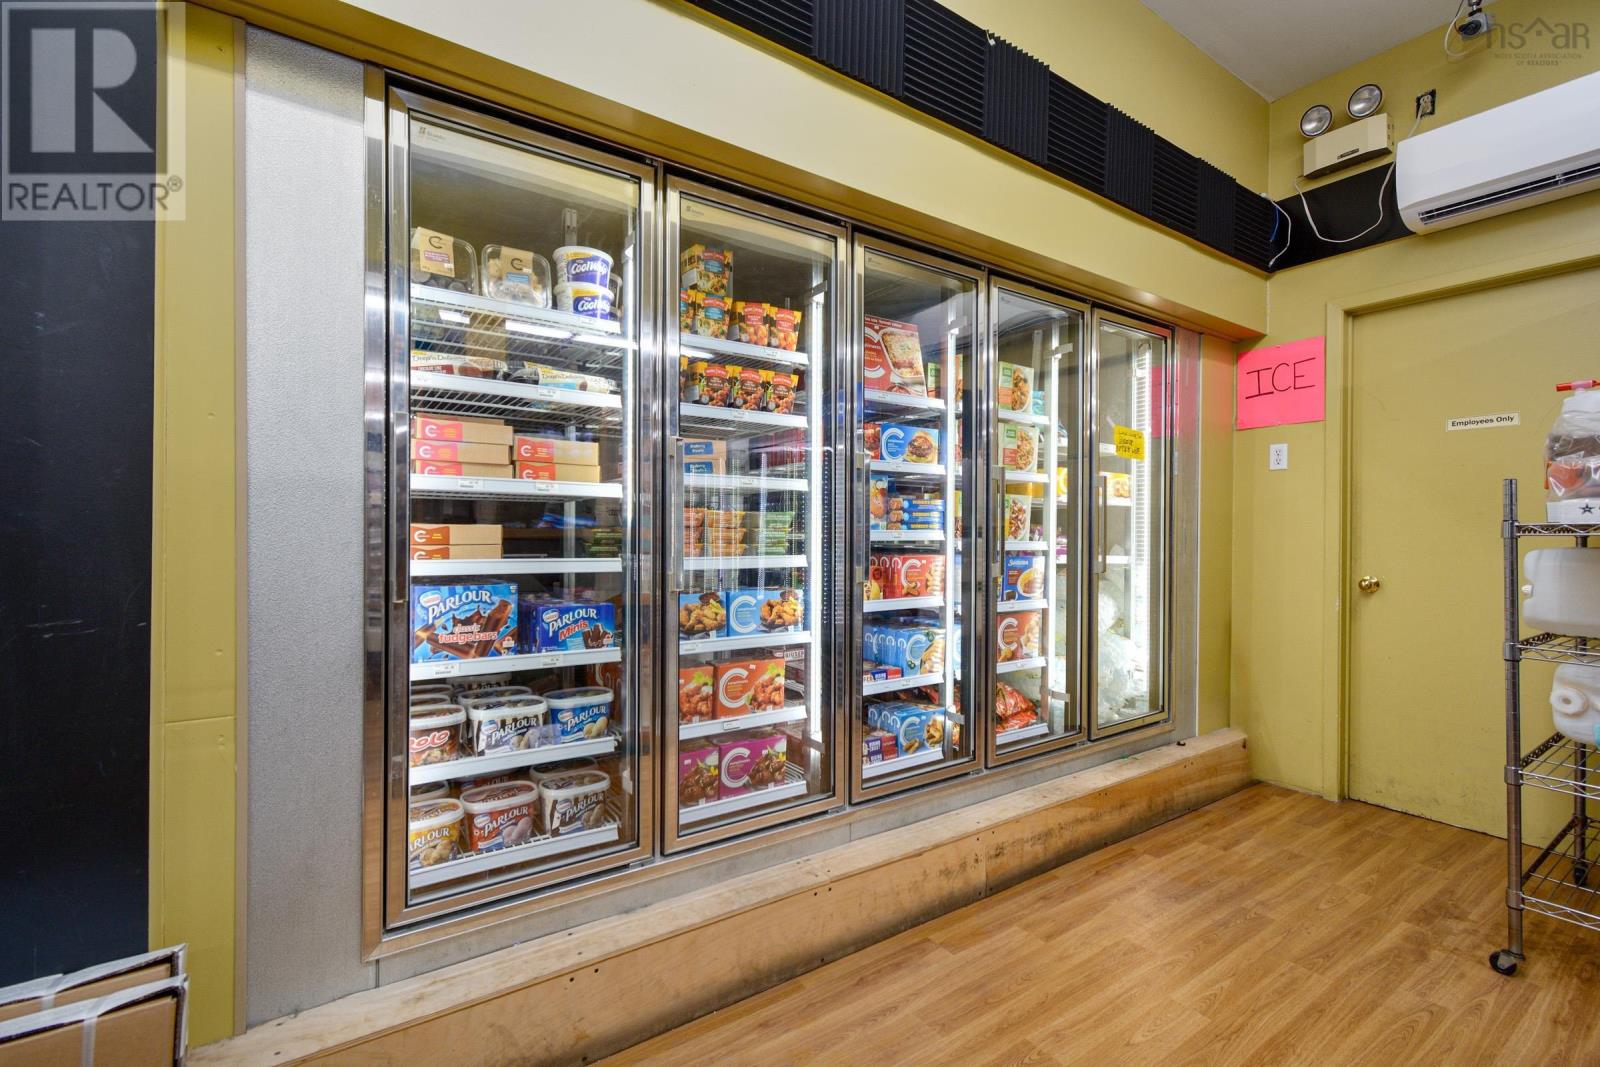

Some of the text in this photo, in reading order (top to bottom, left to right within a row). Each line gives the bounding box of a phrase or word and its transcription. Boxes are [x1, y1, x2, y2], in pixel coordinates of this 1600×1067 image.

[1245, 357, 1316, 399] ICE
[1451, 417, 1494, 427] Employees
[428, 590, 492, 625] PARLOUR
[549, 608, 598, 637] PARLOUR
[559, 619, 589, 642] Minis
[438, 630, 498, 645] fudge bars
[491, 717, 537, 744] PARLOUR
[566, 705, 607, 730] PARLOUR
[566, 792, 604, 822] PARLOUR
[484, 806, 529, 837] PARLOUR
